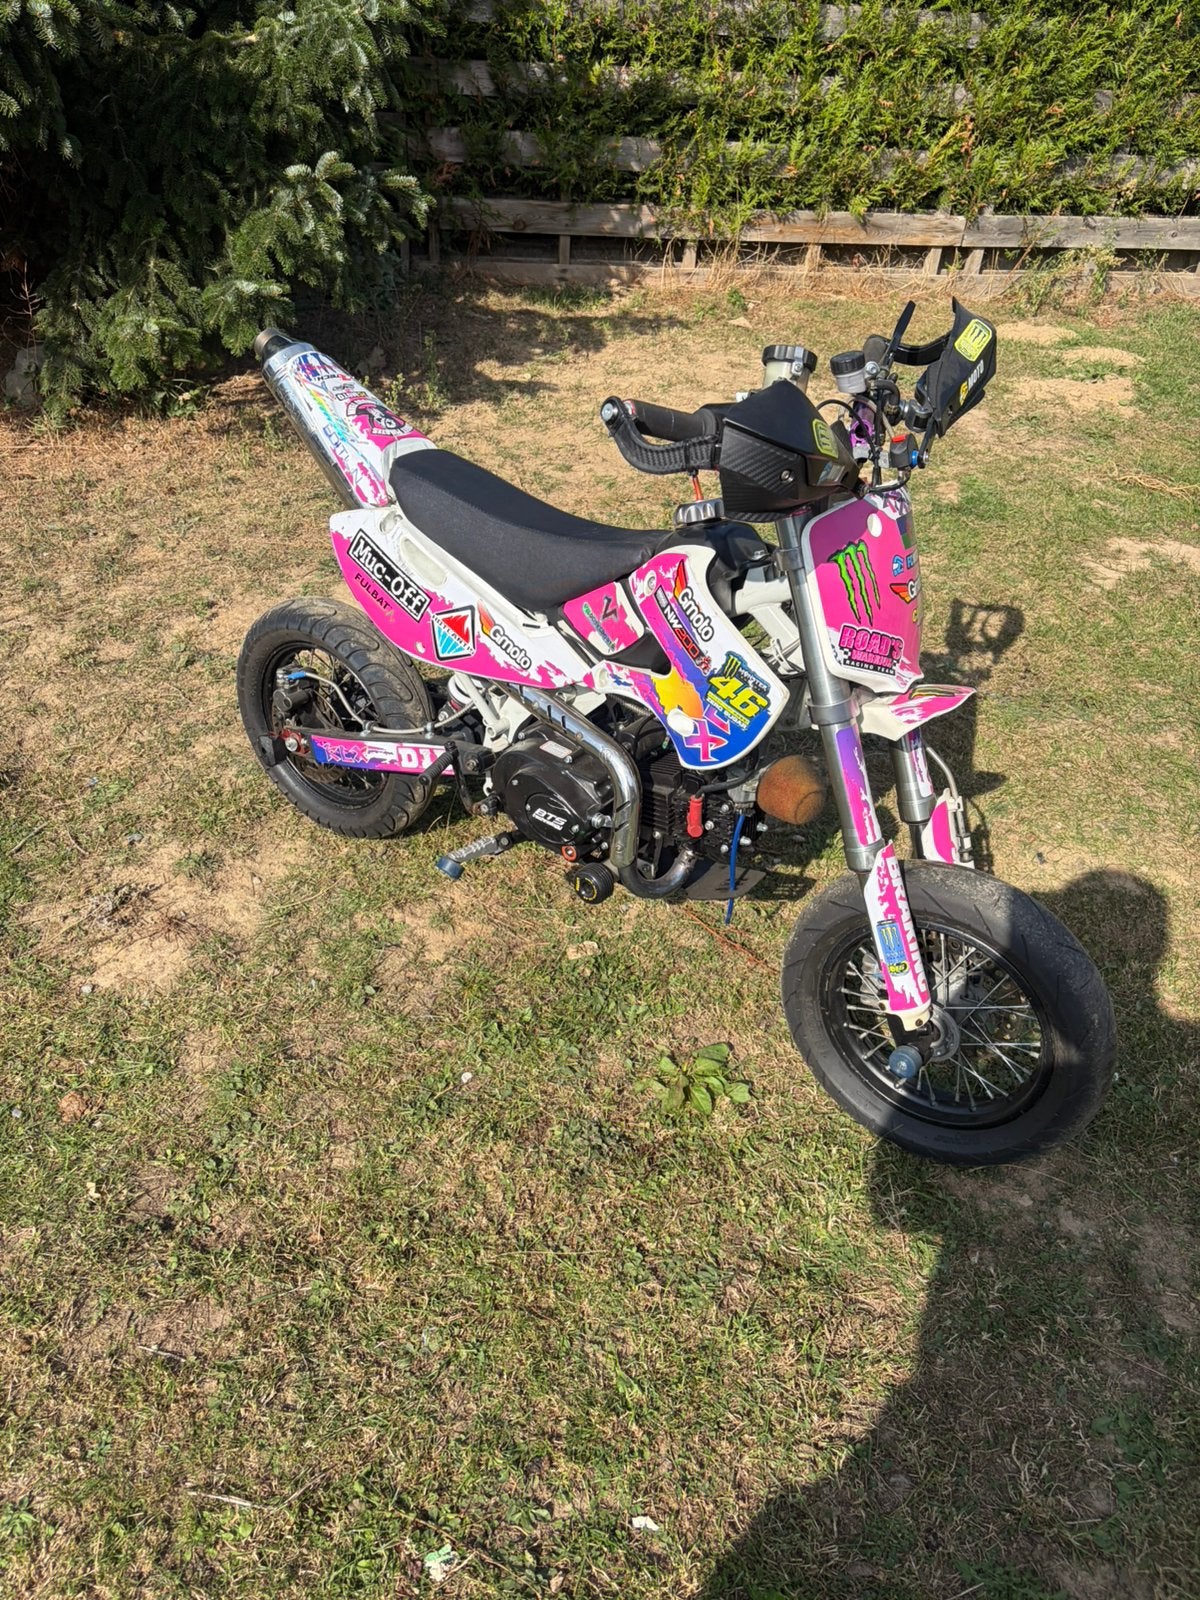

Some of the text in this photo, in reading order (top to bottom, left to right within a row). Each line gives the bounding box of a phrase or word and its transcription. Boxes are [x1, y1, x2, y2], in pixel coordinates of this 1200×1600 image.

[353, 538, 428, 618] Muc-Off
[354, 572, 392, 611] FULBAT
[663, 606, 699, 658] NW200
[680, 586, 714, 642] Gmoto
[490, 624, 532, 671] Gmoto
[839, 625, 903, 660] ROAD'S
[845, 659, 895, 675] RACING TEAM
[709, 676, 768, 718] 46
[532, 807, 568, 826] BTS
[887, 856, 929, 994] BRAKING
